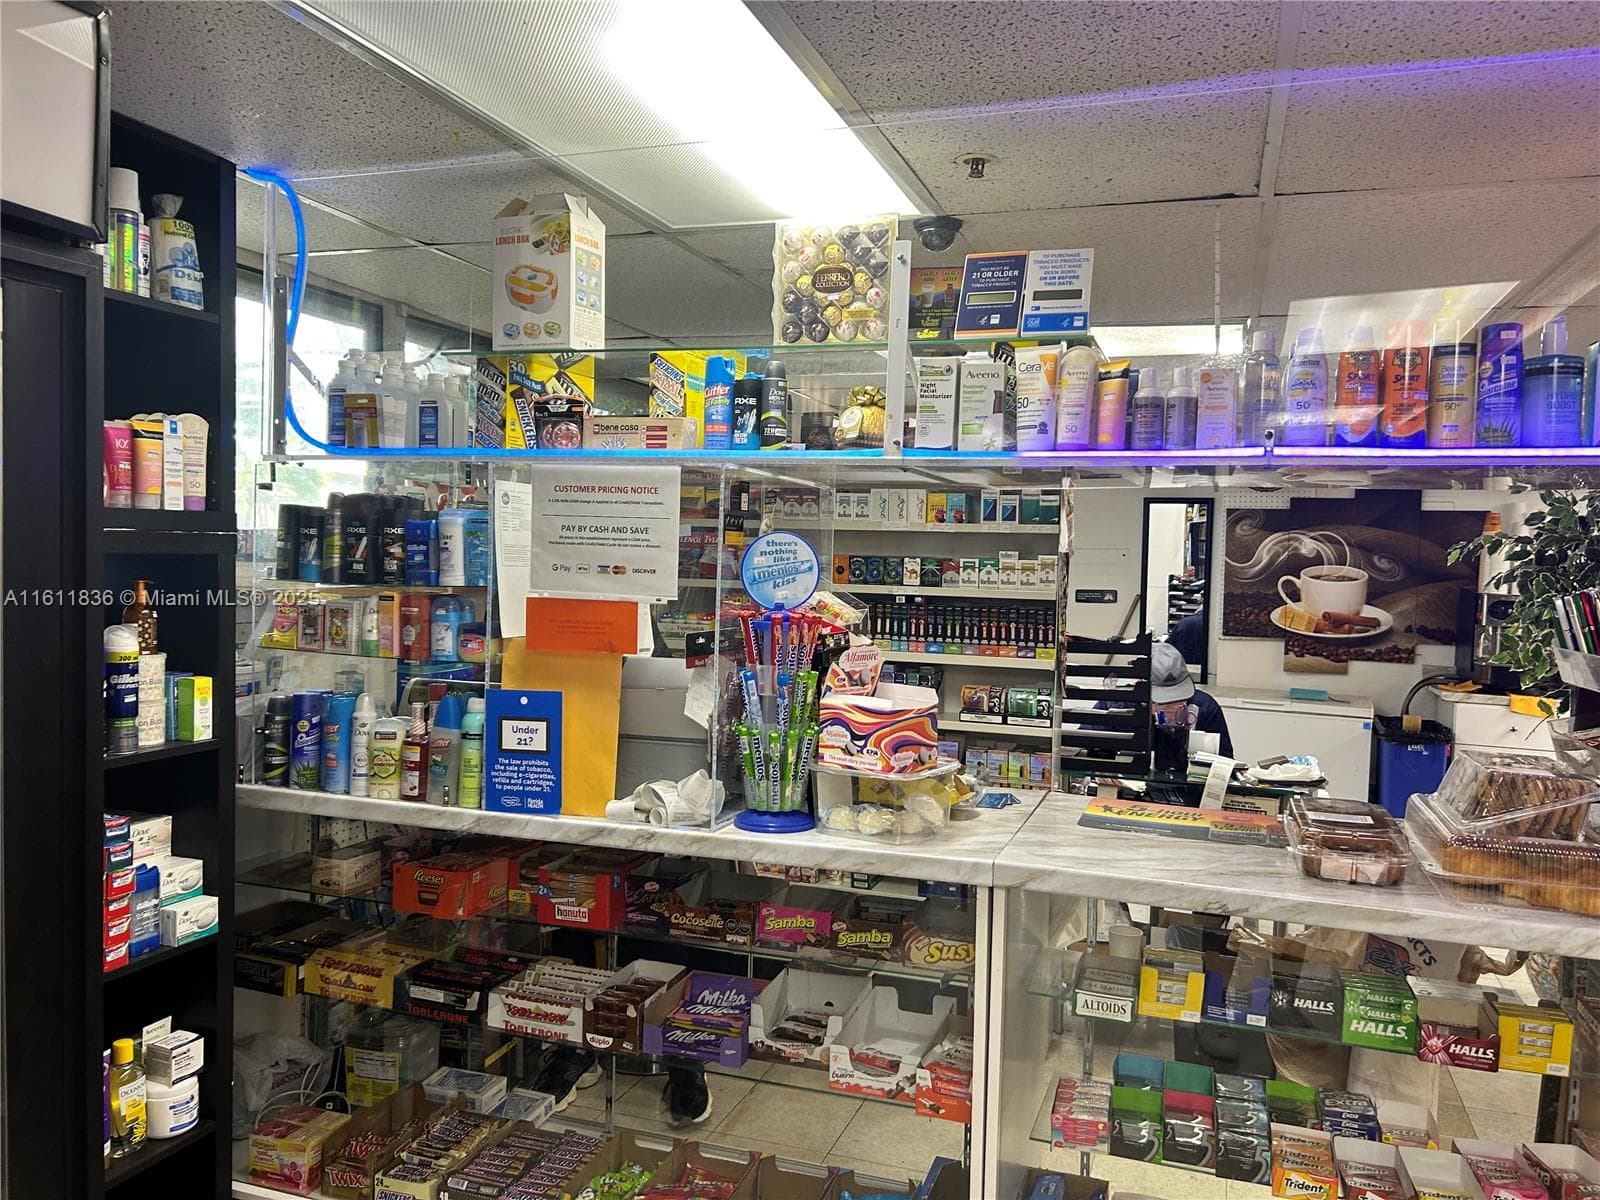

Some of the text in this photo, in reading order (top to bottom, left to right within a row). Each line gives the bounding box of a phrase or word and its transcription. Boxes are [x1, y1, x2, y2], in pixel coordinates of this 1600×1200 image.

[496, 234, 530, 246] LUNCH BOX
[994, 270, 1019, 278] OLDER
[509, 359, 526, 374] 30
[1018, 360, 1055, 373] CeraVe
[966, 370, 1000, 379] Aveeno
[705, 385, 731, 398] Cutter
[1017, 397, 1029, 409] 50
[1296, 401, 1311, 410] 50
[516, 398, 537, 450] SNICKERS
[600, 424, 639, 432] bene casa
[1065, 424, 1078, 434] 50
[554, 485, 659, 495] CUSTOMER PRICING NOTICE
[384, 527, 405, 535] AXE
[561, 524, 650, 535] PAY BY CASH AND SAVE
[760, 548, 798, 557] nothing
[773, 556, 791, 564] like
[560, 564, 571, 573] Pay
[757, 563, 799, 580] mentos
[772, 576, 797, 590] kiss
[843, 650, 879, 664] Alfamore
[512, 726, 540, 735] Under
[516, 737, 534, 747] 21?
[522, 759, 549, 768] prohibits
[753, 736, 766, 782] mentos
[800, 738, 813, 782] mentos
[491, 771, 557, 781] including e-cigarettes,
[526, 766, 553, 774] tobacco,
[504, 784, 524, 792] people
[523, 778, 555, 787] cartridges,
[771, 762, 780, 806] mentos
[132, 827, 151, 839] Dove
[556, 907, 588, 919] hanuta
[766, 917, 816, 932] Samba
[838, 930, 893, 947] Samba
[698, 990, 746, 1008] Milka
[1082, 998, 1127, 1015] ALTOIDS
[1294, 998, 1335, 1013] HALLS
[406, 1004, 469, 1024] TOBLERONE
[1367, 1010, 1399, 1020] HALLS
[503, 1020, 569, 1041] TOBLERONE
[1350, 1019, 1408, 1040] HALLS
[589, 1036, 610, 1047] duplo
[668, 1030, 717, 1042] Milka
[1450, 1043, 1495, 1060] HALLS
[831, 1072, 855, 1080] bueno
[1280, 1149, 1322, 1161] Trident
[1282, 1158, 1325, 1170] Trident
[325, 1166, 366, 1188] TWIX
[376, 1177, 384, 1187] 24
[1284, 1178, 1324, 1193] Trident
[1348, 1180, 1394, 1191] Trident
